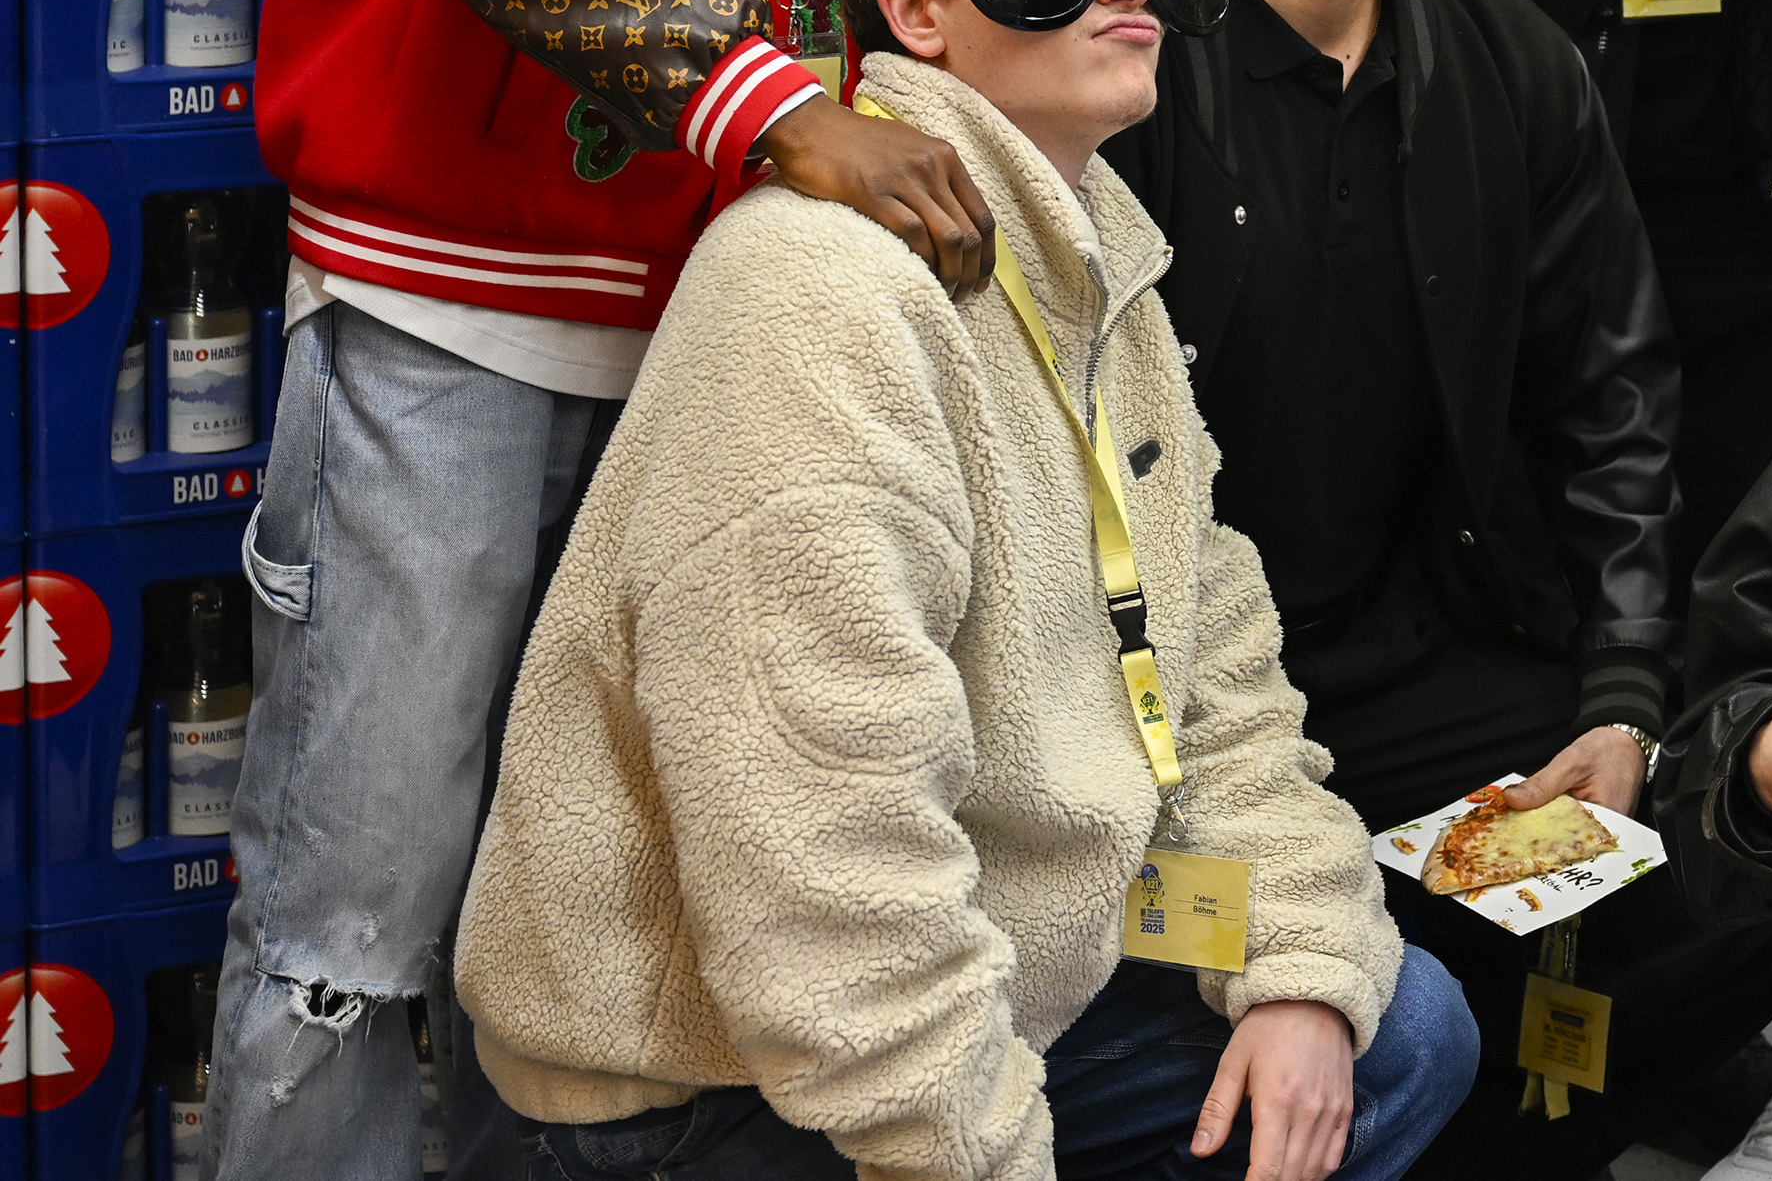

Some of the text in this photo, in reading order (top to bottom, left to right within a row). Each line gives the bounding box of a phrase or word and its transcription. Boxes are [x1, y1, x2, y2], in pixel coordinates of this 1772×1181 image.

[169, 85, 215, 116] BAD
[173, 349, 193, 362] BAD
[173, 473, 219, 504] BAD
[174, 859, 218, 891] BAD
[1145, 880, 1159, 890] U21
[1194, 894, 1218, 904] Fabian
[1193, 905, 1218, 916] Böhme
[1140, 923, 1165, 935] 2025
